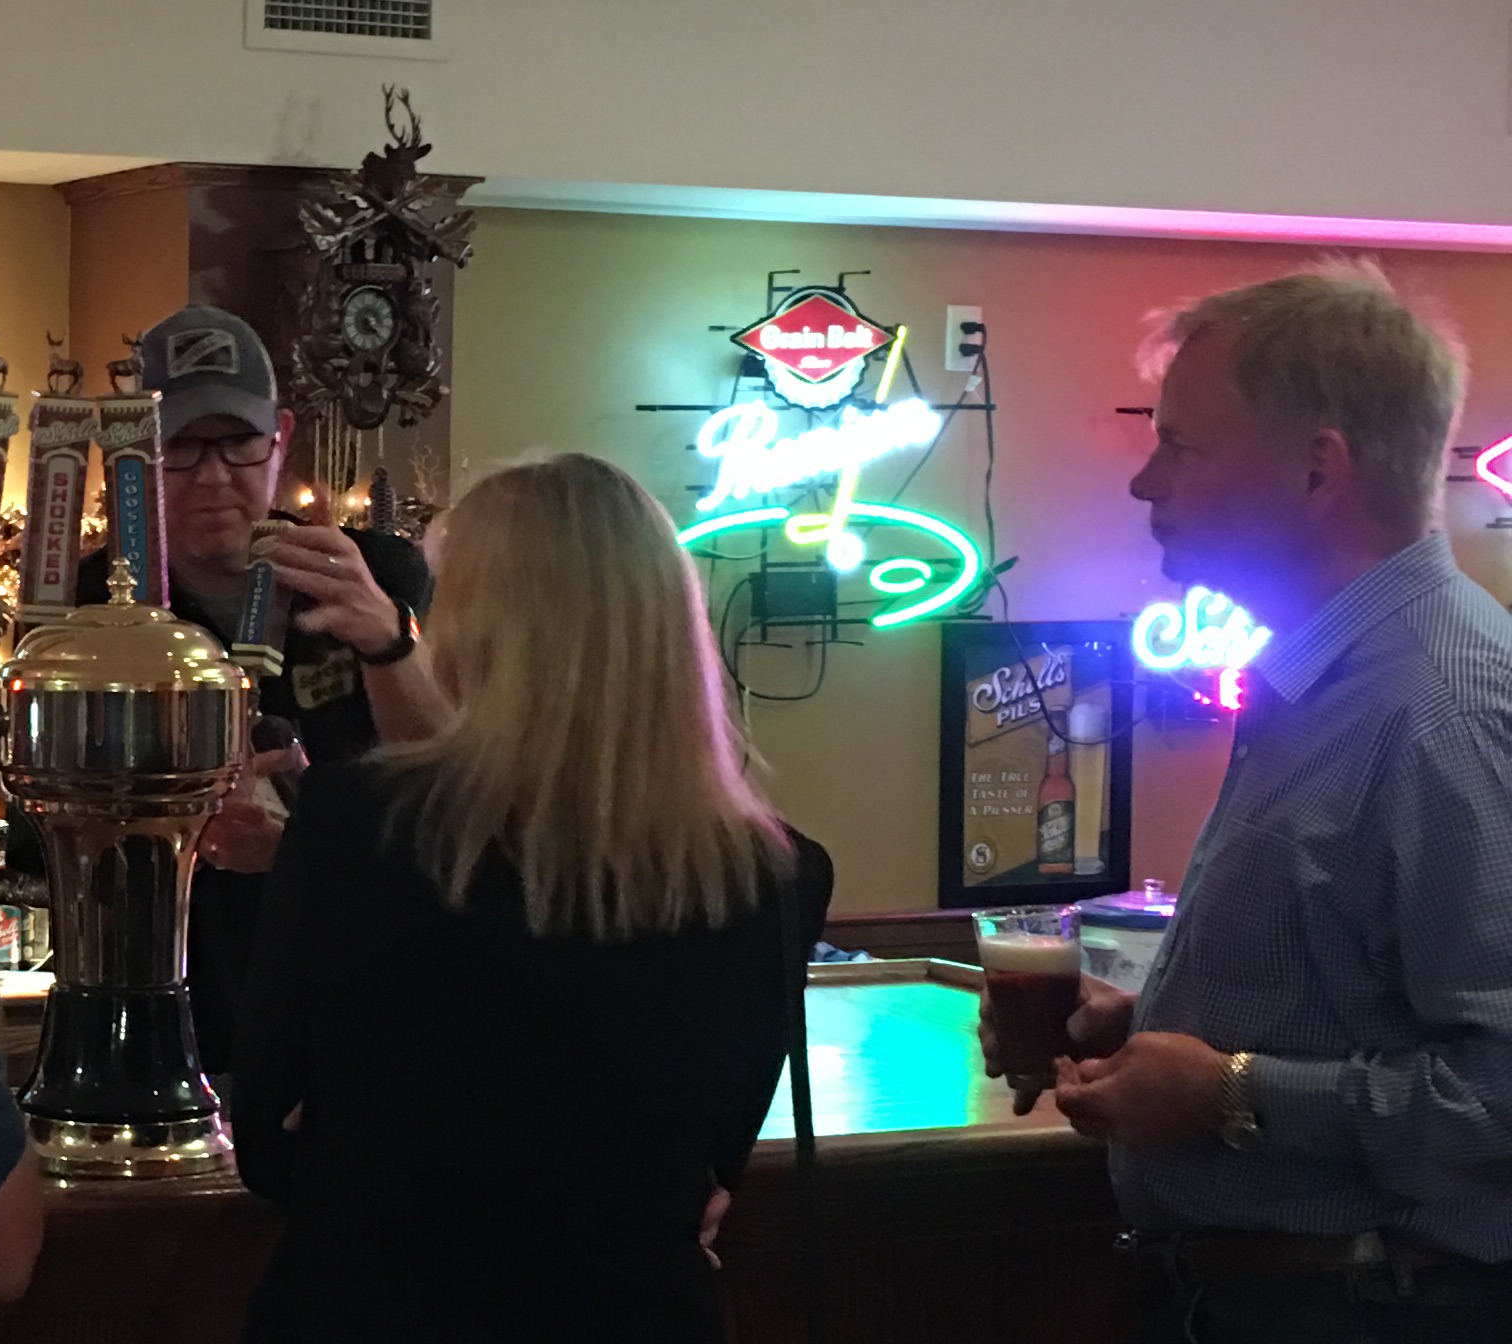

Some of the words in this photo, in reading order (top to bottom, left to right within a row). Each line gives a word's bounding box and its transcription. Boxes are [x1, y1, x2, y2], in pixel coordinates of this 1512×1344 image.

[759, 324, 825, 350] Grain
[827, 324, 875, 349] Belt
[43, 472, 69, 586] SHOCKED
[123, 471, 143, 575] GOOSETOW
[996, 698, 1042, 727] PILS
[970, 772, 993, 783] THE
[972, 788, 1009, 799] TASTE
